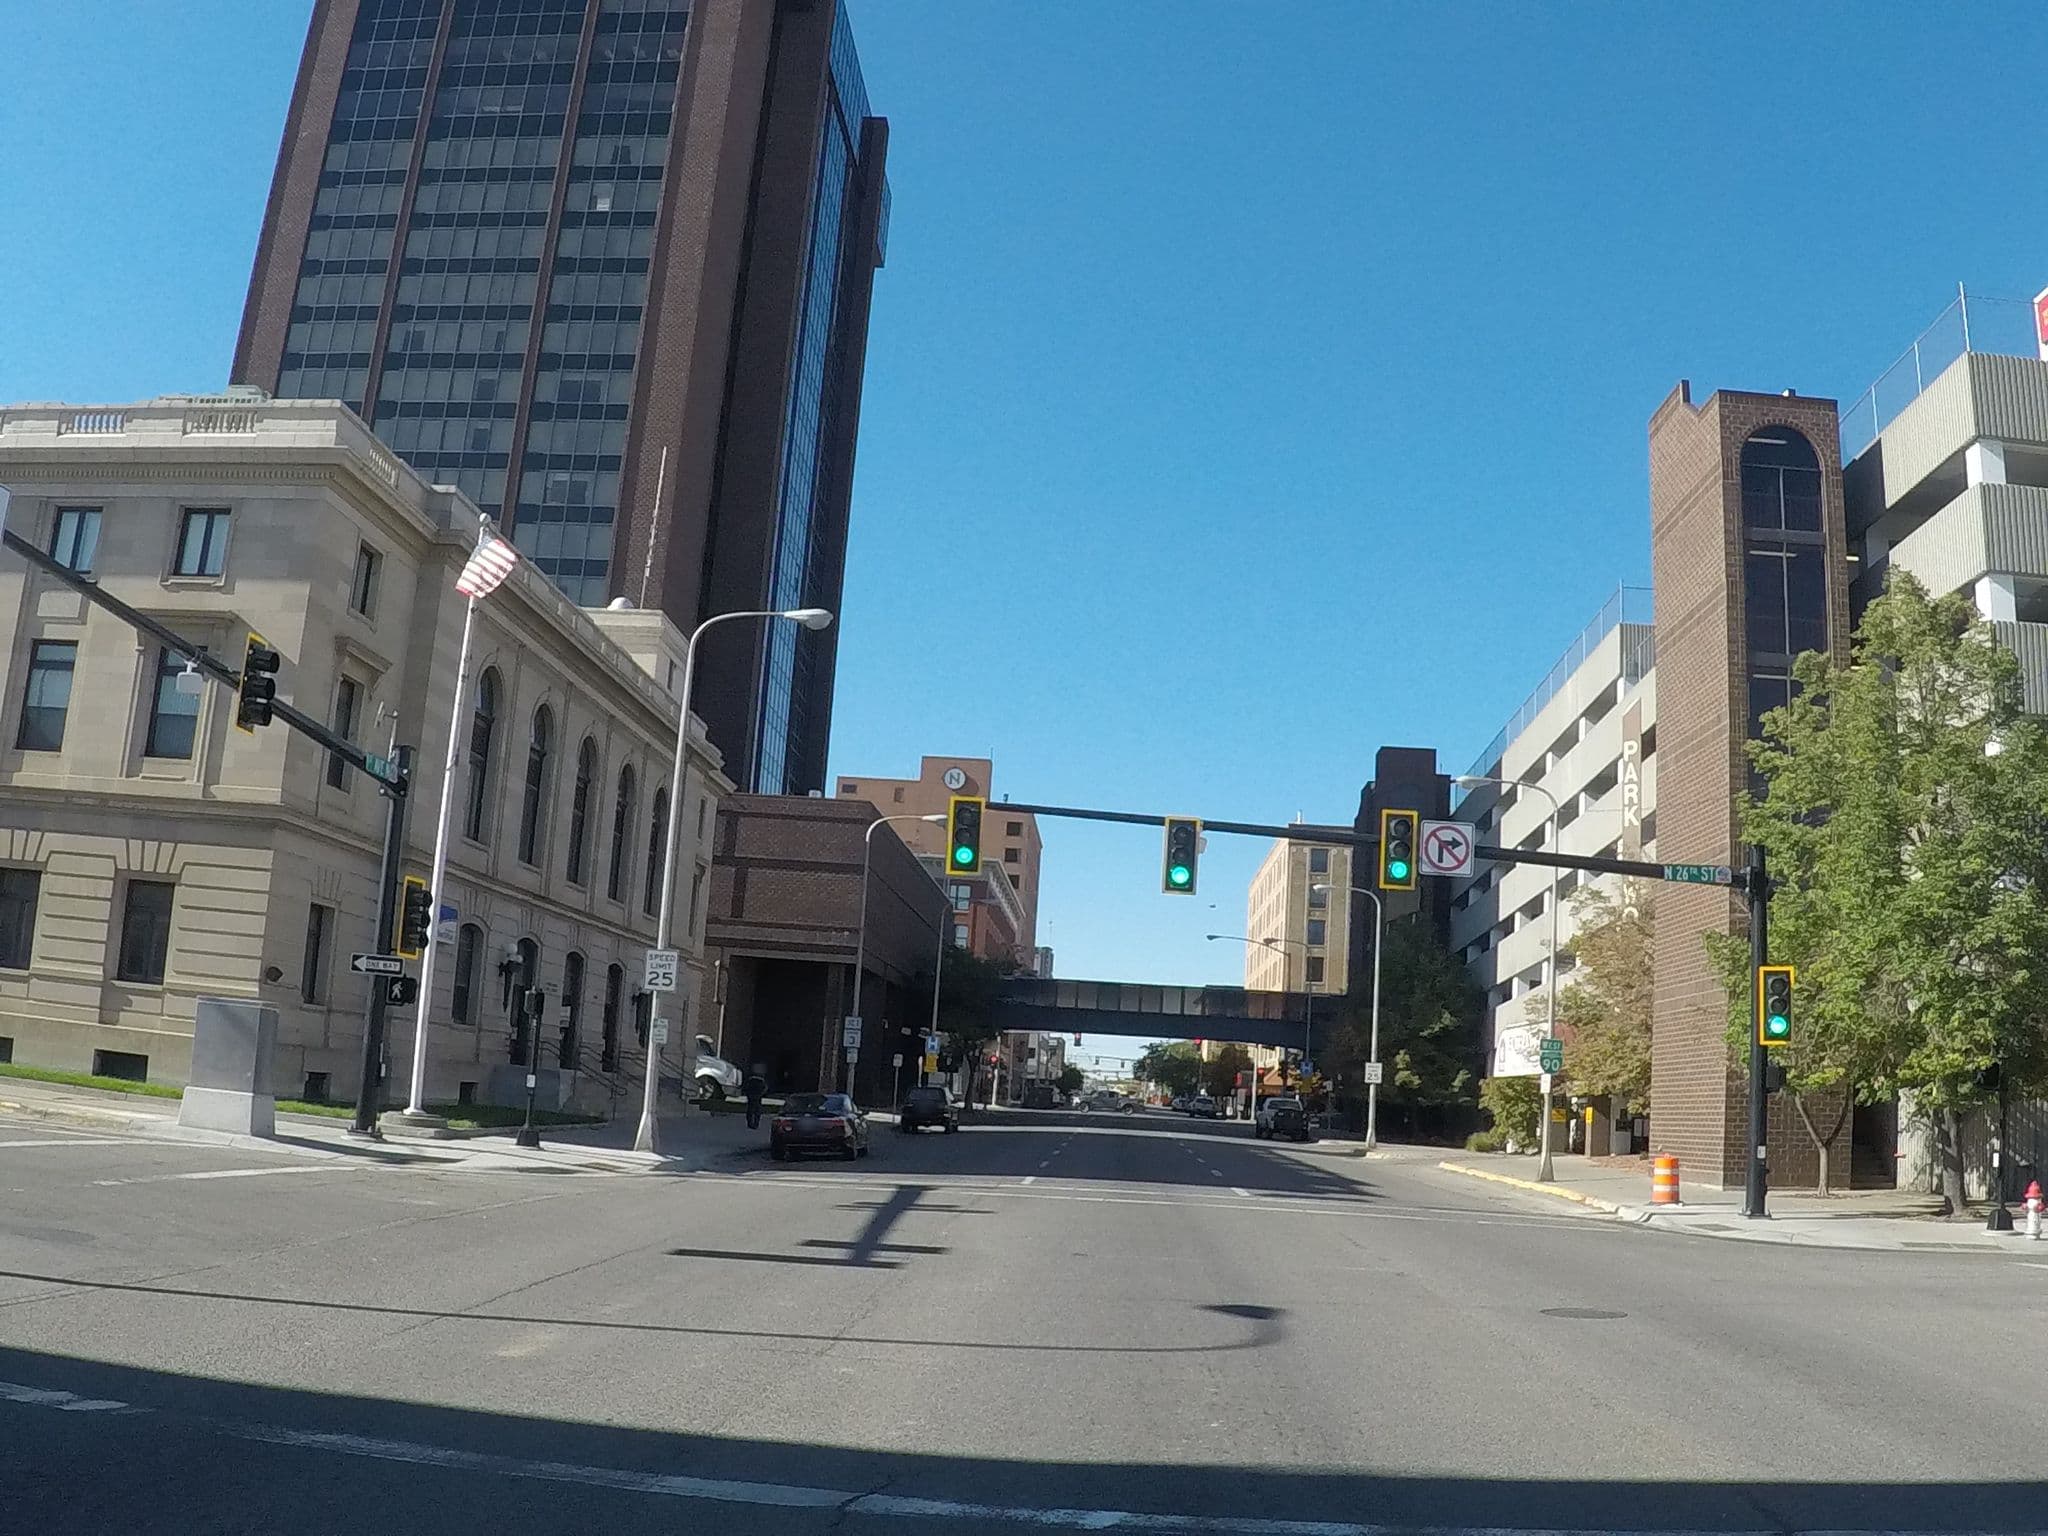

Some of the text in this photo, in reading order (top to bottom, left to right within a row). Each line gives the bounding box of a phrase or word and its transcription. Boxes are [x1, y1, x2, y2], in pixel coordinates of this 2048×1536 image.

[949, 772, 961, 785] N
[1623, 740, 1640, 827] PARK
[1664, 866, 1673, 880] N
[1700, 867, 1715, 881] ST
[366, 960, 380, 968] ONE
[649, 954, 676, 962] SPEED
[647, 971, 673, 987] 25
[1543, 1042, 1561, 1050] WEST
[1543, 1059, 1560, 1072] 90
